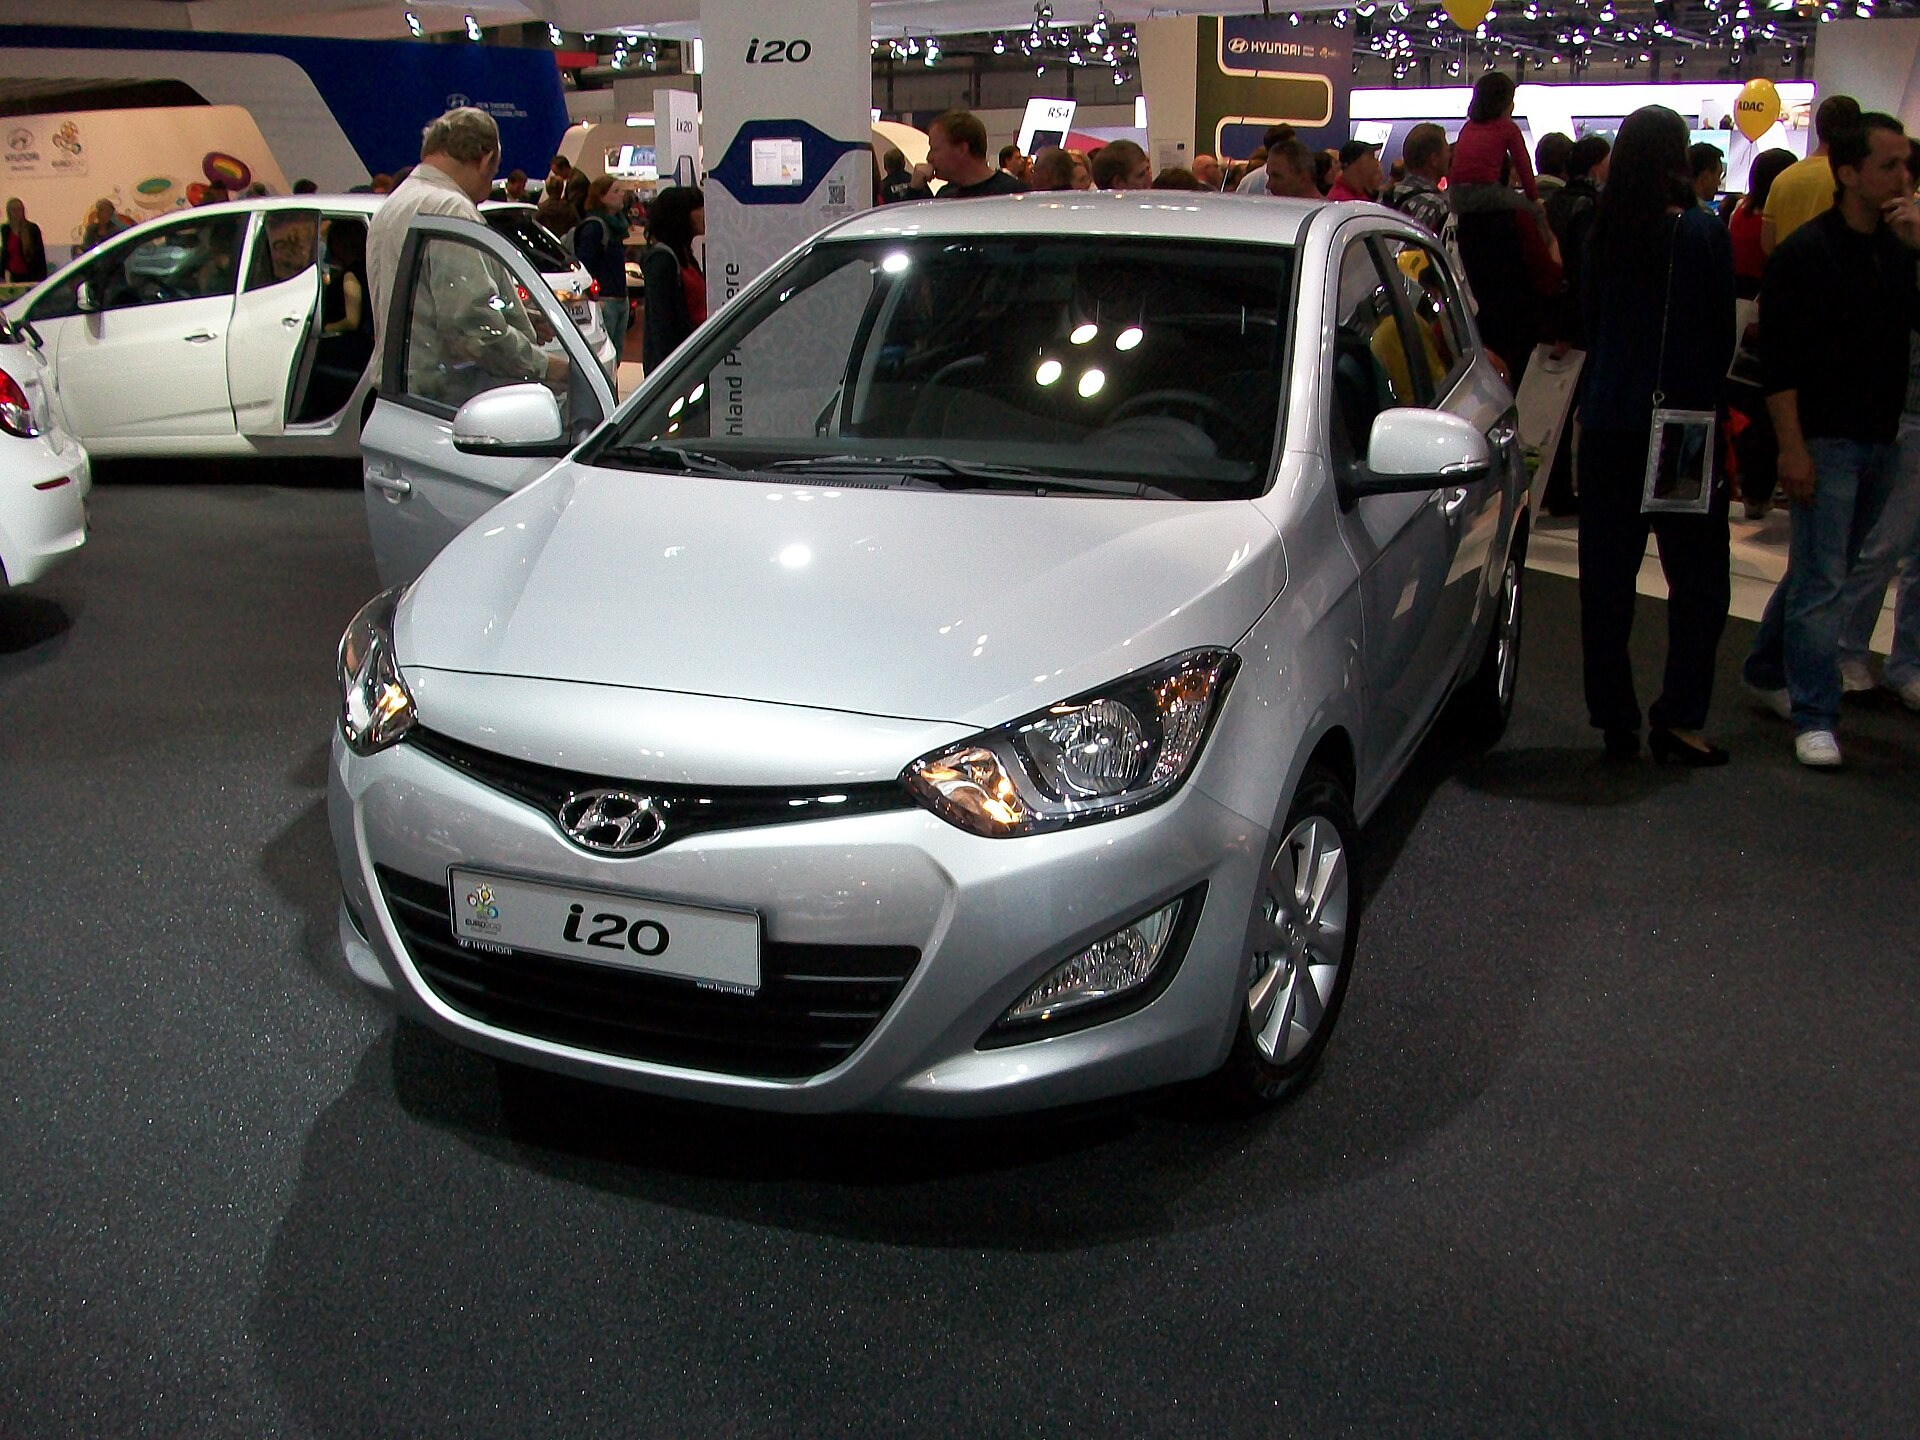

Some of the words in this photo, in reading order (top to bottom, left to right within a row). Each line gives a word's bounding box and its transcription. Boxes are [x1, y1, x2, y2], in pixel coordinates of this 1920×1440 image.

[746, 38, 811, 63] i20
[1251, 41, 1300, 57] HYUNDAI
[1737, 101, 1764, 112] ADAC
[562, 903, 670, 956] i20
[472, 940, 512, 956] HYUNDAI
